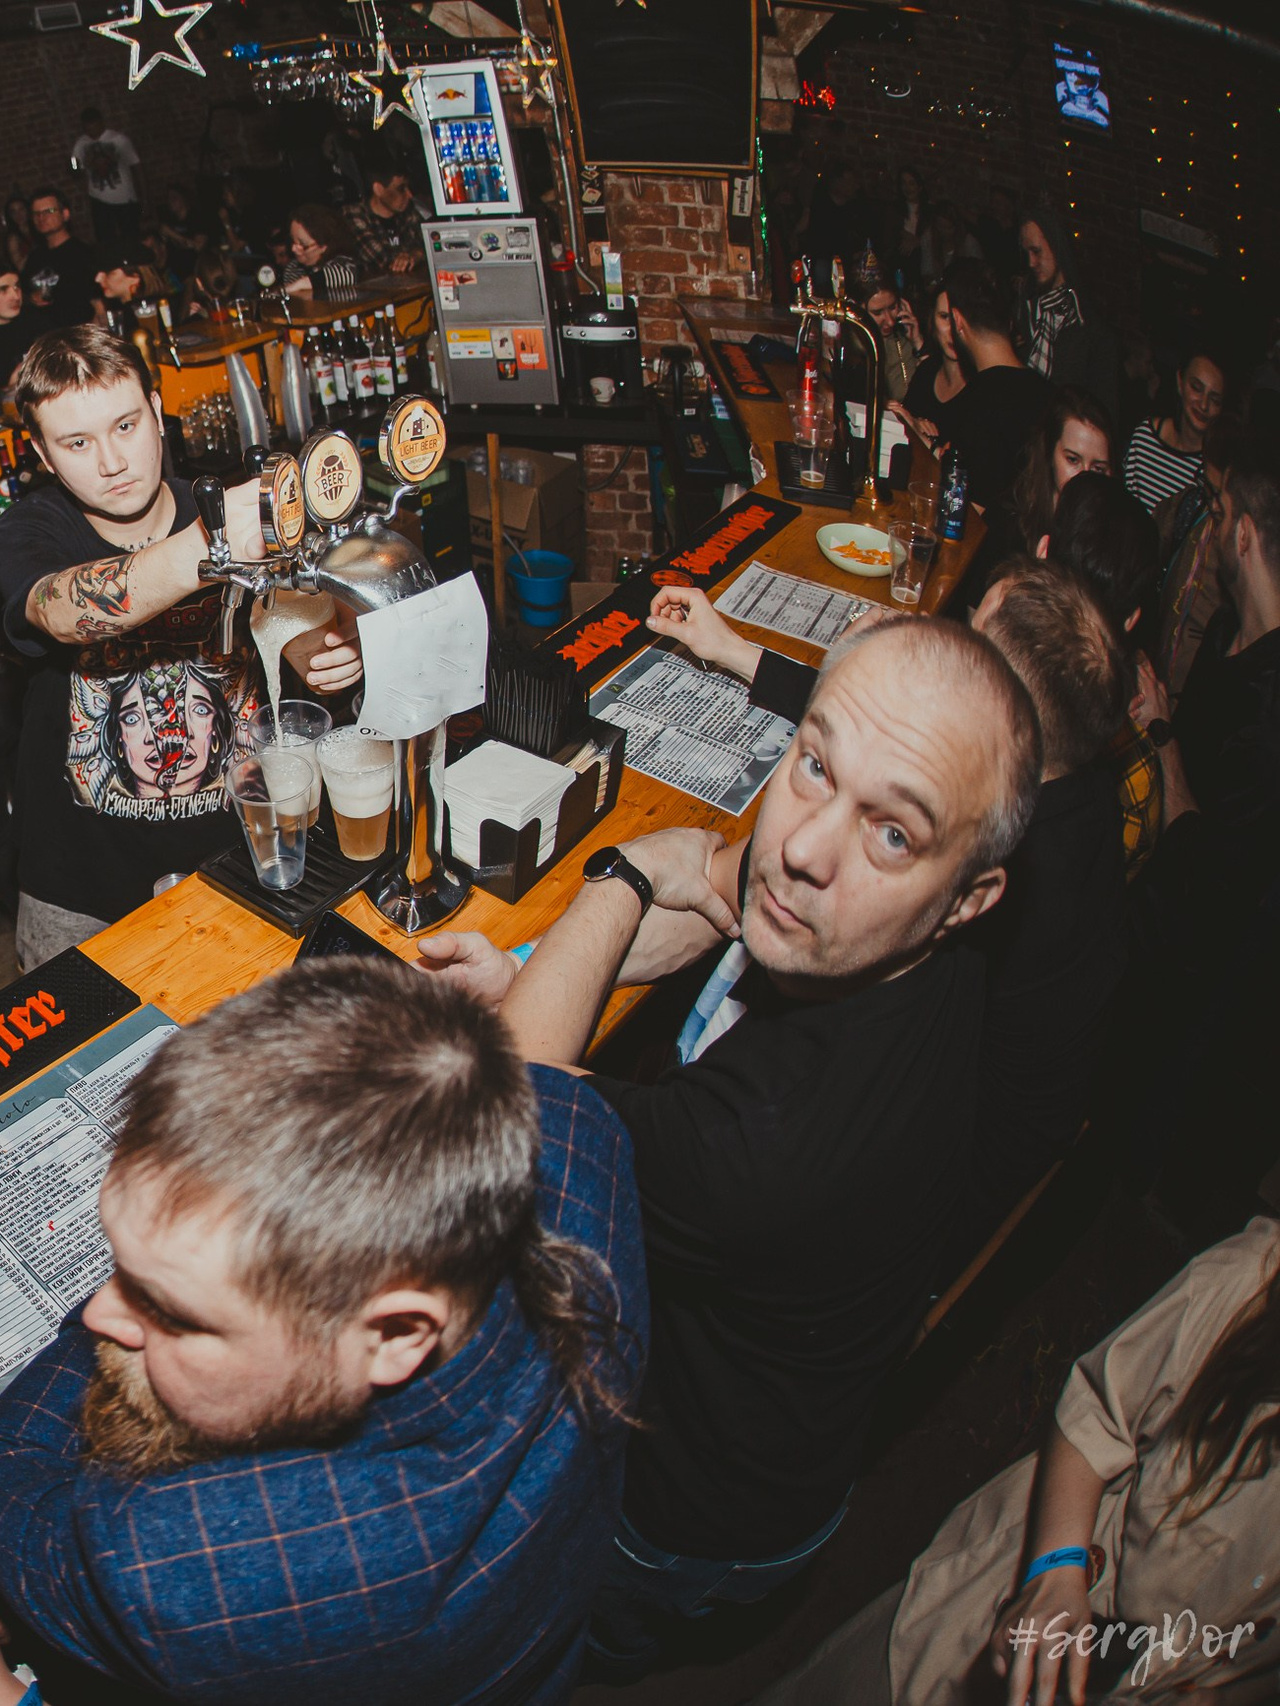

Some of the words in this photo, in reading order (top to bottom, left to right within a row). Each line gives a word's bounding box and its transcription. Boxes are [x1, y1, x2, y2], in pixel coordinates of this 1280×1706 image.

[400, 440, 417, 454] LIGHT
[420, 438, 437, 451] BEER
[321, 474, 344, 489] BEER
[69, 1079, 87, 1094] ПИВО
[2, 1168, 22, 1185] ЛОНГИ
[51, 1264, 85, 1290] КОКТЕЙЛИ
[82, 1246, 110, 1269] ГОРЯЧИЕ
